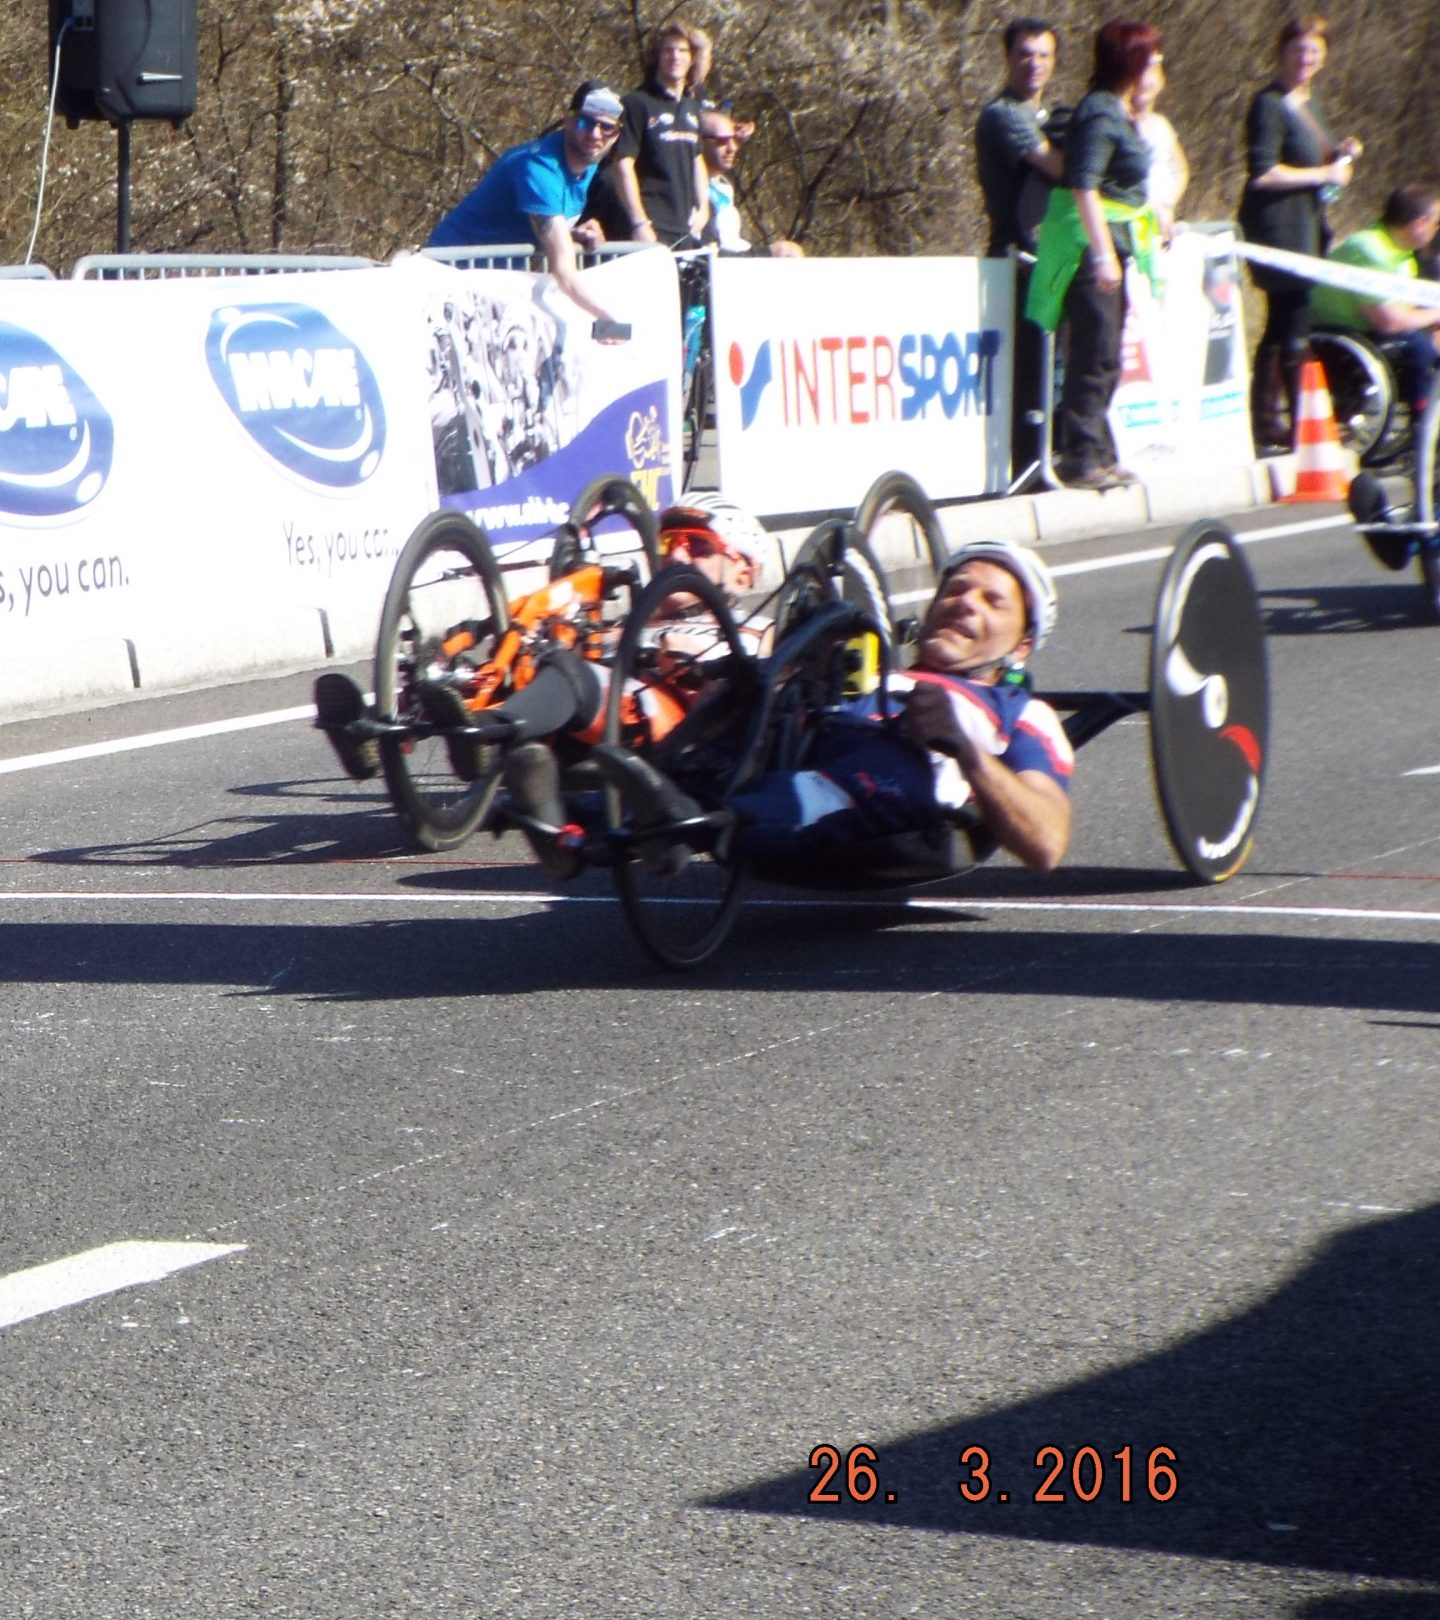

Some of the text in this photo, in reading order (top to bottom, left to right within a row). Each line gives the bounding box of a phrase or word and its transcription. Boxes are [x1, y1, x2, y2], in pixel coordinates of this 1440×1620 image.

[779, 329, 1000, 425] INTERSPORT
[324, 530, 358, 579] you
[18, 567, 70, 615] you
[78, 556, 130, 589] can.
